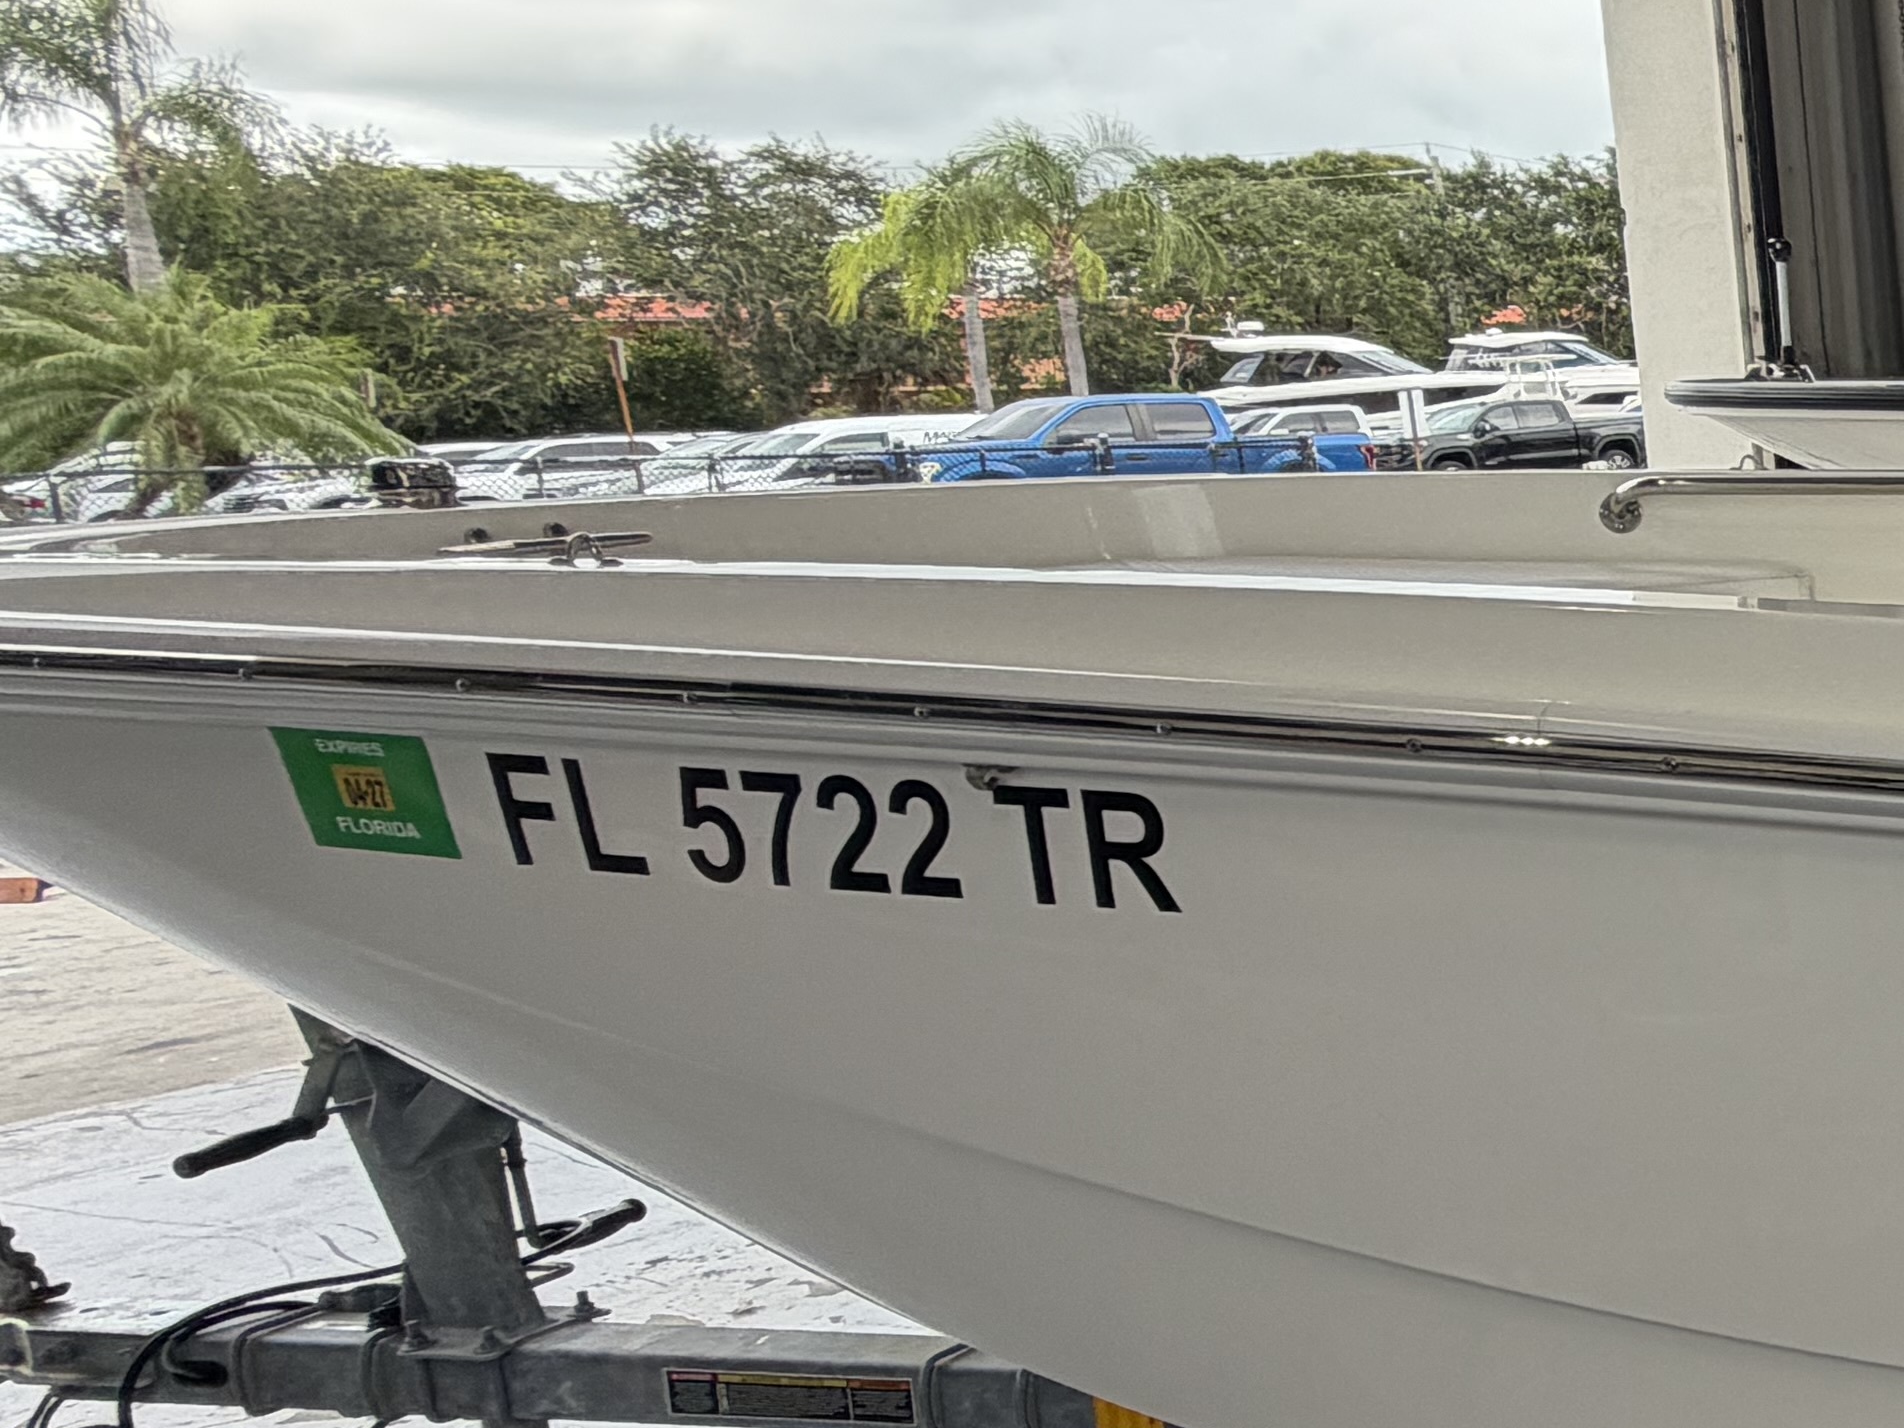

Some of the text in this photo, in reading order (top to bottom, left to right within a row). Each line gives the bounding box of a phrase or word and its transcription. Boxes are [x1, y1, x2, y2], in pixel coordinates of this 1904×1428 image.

[314, 738, 385, 758] EXPIRES
[335, 815, 422, 840] FLORIDA
[485, 752, 1182, 912] FL 5722 TR
